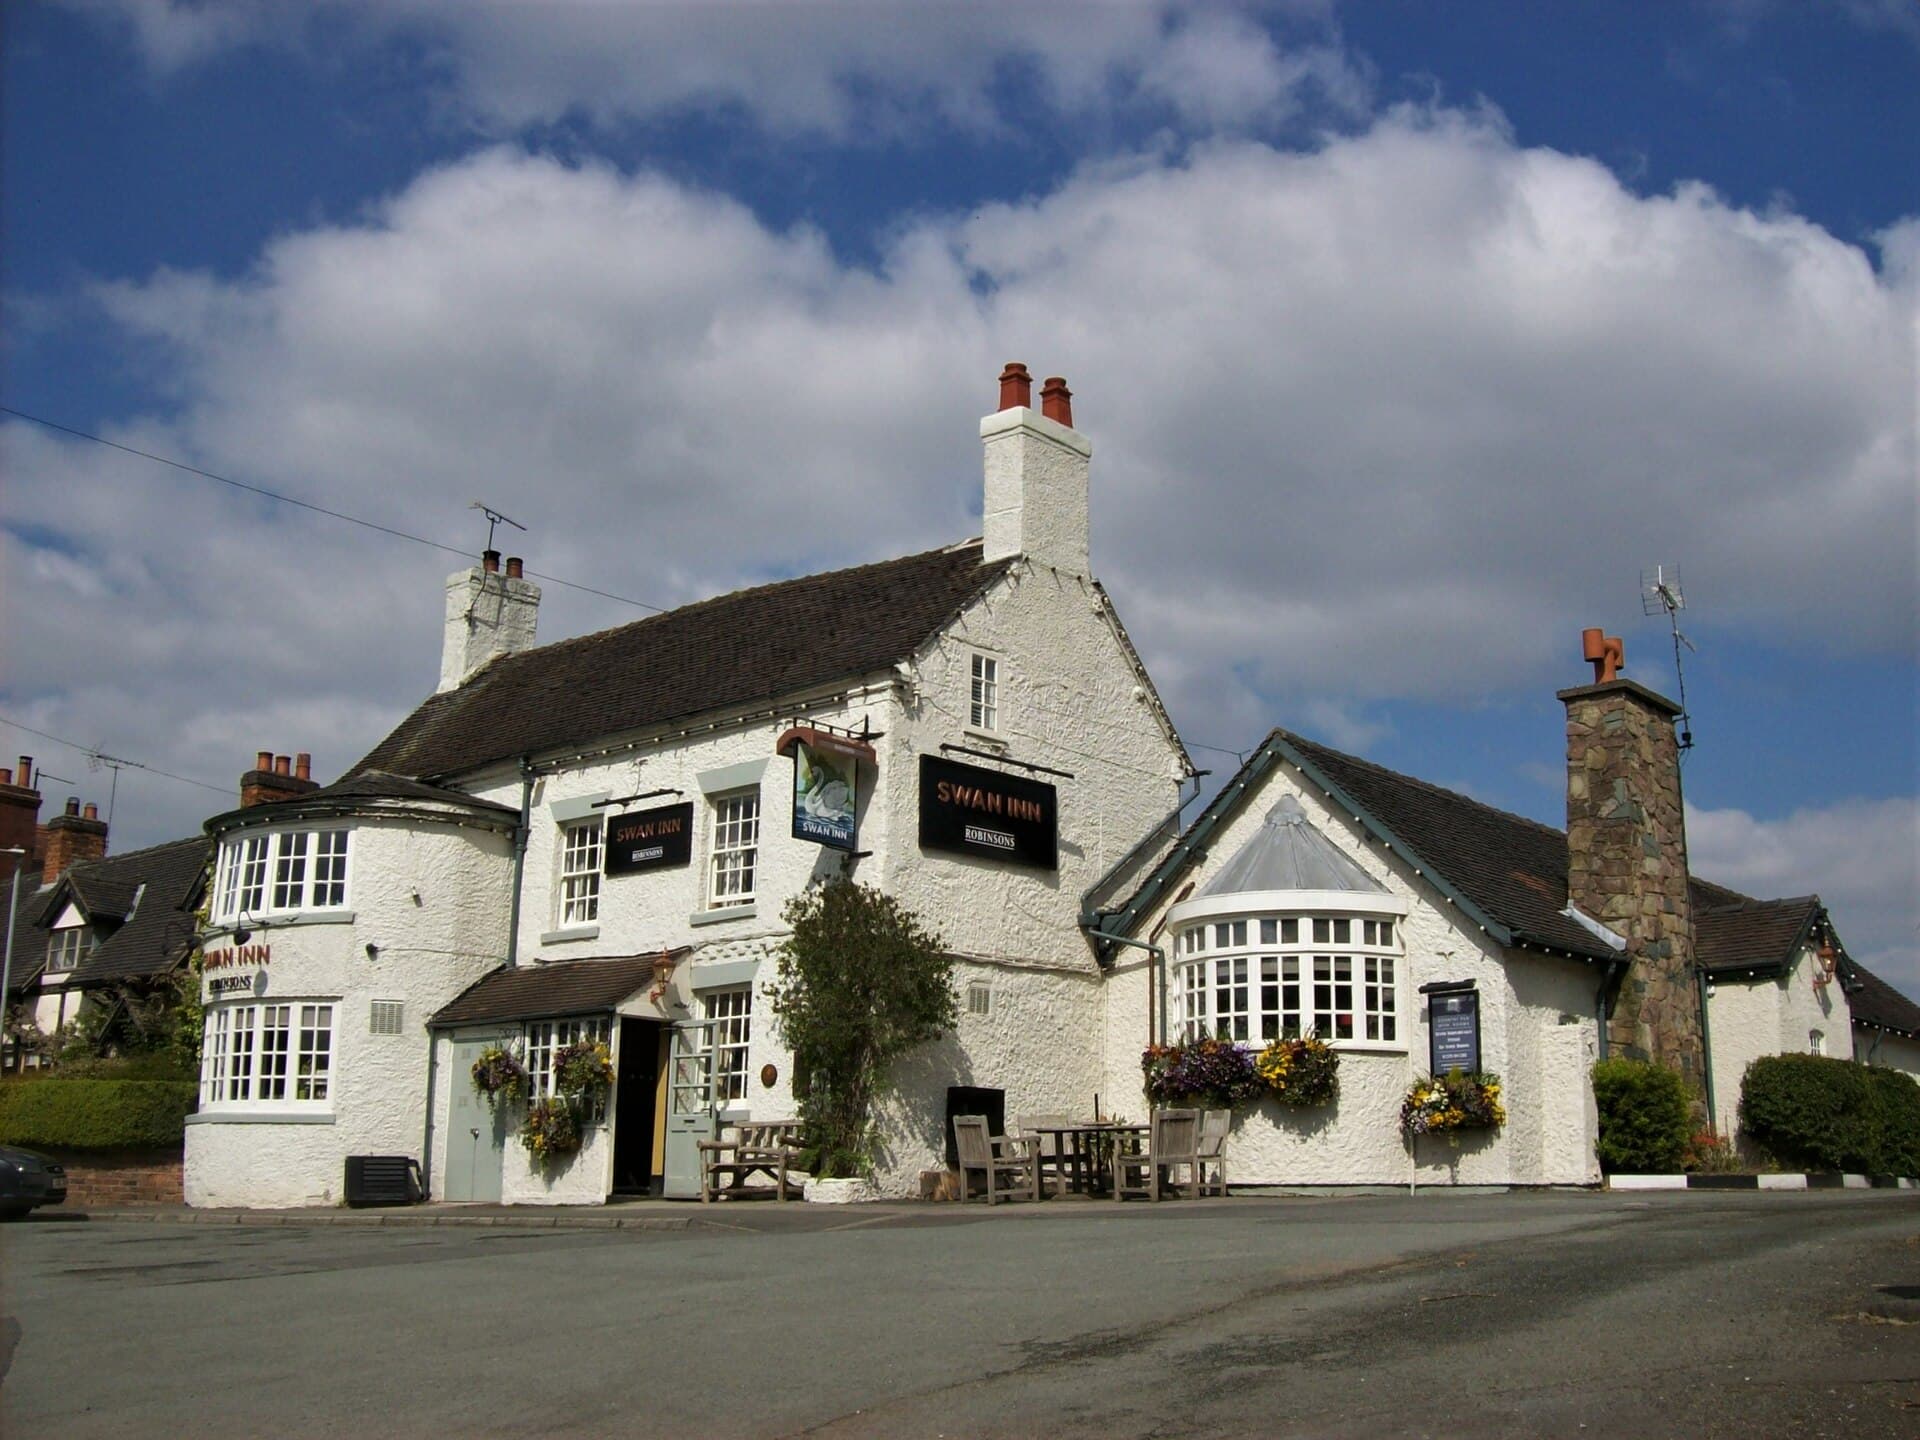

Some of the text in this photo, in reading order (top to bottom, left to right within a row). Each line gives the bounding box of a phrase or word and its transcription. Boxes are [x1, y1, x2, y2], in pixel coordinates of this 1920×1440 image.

[937, 781, 1041, 823] SWAN INN
[617, 817, 681, 842] SWAN INN
[802, 821, 847, 840] SWAN INN
[965, 828, 1015, 848] ROBINSONS
[238, 944, 270, 967] INN
